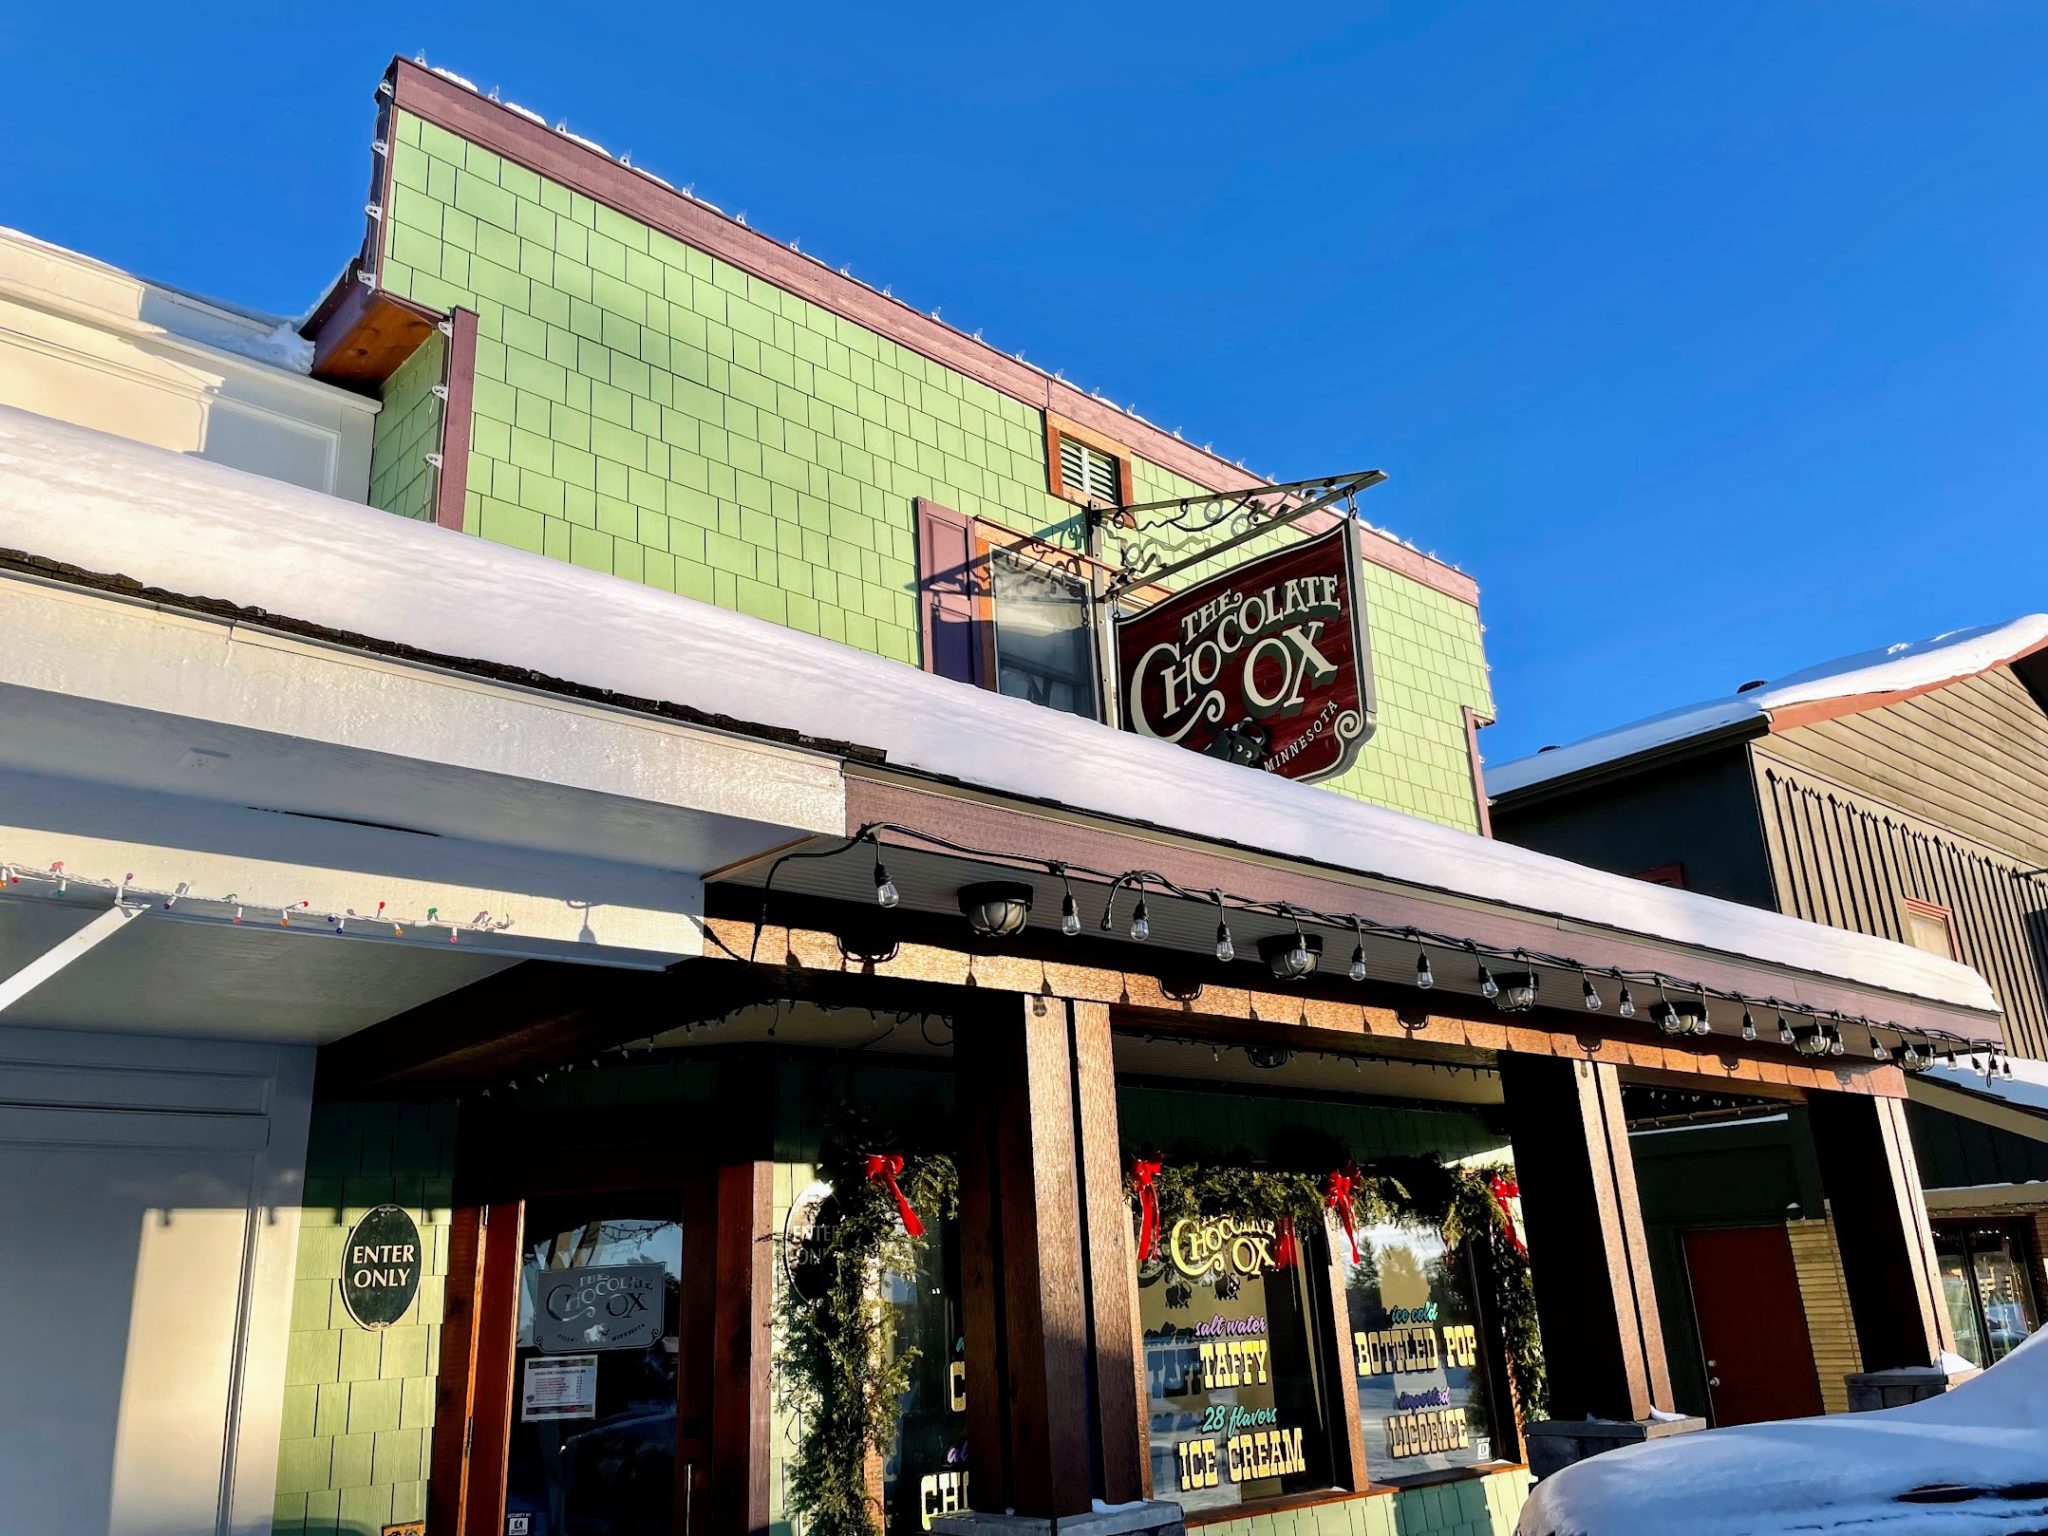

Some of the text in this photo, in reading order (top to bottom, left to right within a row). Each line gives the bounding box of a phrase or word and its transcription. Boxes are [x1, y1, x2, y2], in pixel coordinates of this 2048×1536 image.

[1181, 588, 1243, 646] THE
[1130, 574, 1341, 743] CHOCOLATE
[1243, 621, 1338, 708] OX
[1264, 699, 1338, 773] MINNESOTA
[352, 1244, 415, 1264] ENTER
[353, 1268, 411, 1288] ONLY
[1232, 1237, 1276, 1275] OX
[606, 1292, 648, 1318] OX
[1195, 1314, 1267, 1337] salt water
[1391, 1301, 1439, 1324] ice cold
[1200, 1340, 1268, 1388] TAFFY
[1354, 1325, 1477, 1376] BOTTLED POP
[1202, 1404, 1277, 1438] 28 flavors
[1387, 1408, 1469, 1459] LICORICE
[1179, 1427, 1306, 1491] ICE CREAM
